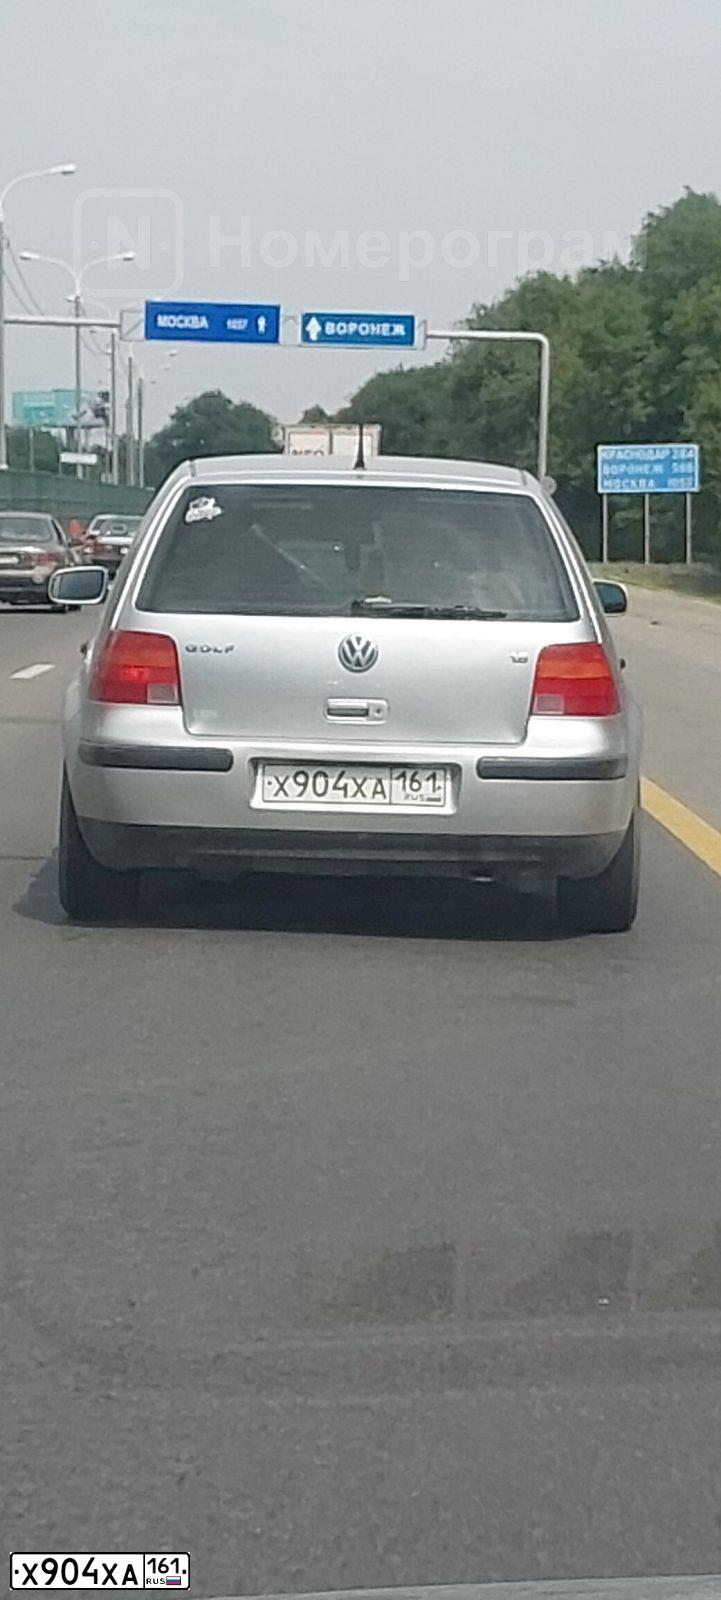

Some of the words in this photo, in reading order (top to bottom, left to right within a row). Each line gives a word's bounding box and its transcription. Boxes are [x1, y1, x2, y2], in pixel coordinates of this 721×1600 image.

[157, 313, 209, 330] МОСКВА
[325, 321, 405, 336] ВОРОНЕЖ
[602, 463, 663, 475] ВОРОНЕЖ
[603, 478, 655, 489] МОСКВА
[185, 642, 235, 653] GOLF
[273, 770, 387, 799] Х904ХА
[395, 770, 438, 793] 161
